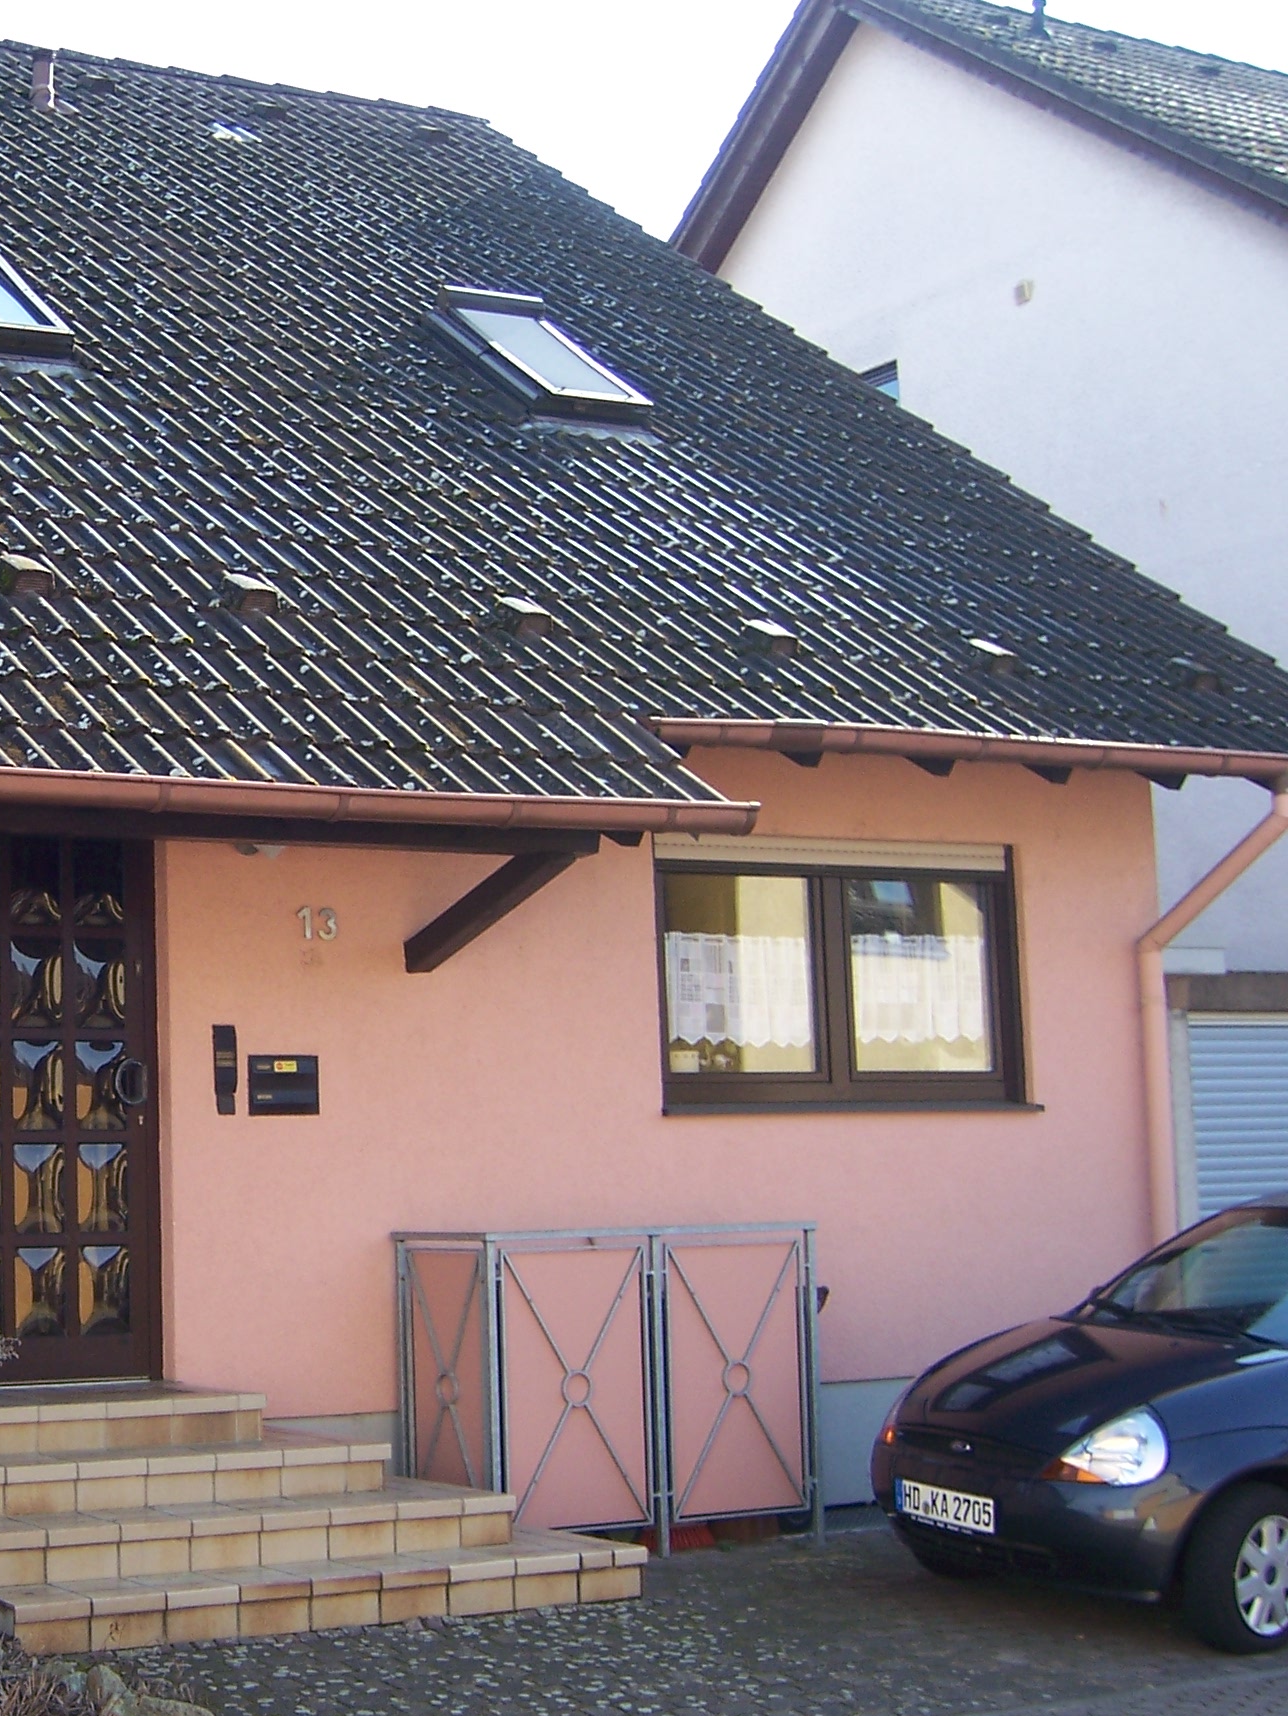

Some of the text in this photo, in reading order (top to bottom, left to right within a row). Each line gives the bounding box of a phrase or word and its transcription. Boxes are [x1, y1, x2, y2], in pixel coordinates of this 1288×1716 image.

[295, 905, 338, 941] 13
[903, 1483, 921, 1511] HD
[930, 1490, 949, 1519] KA
[953, 1496, 992, 1527] 2705
